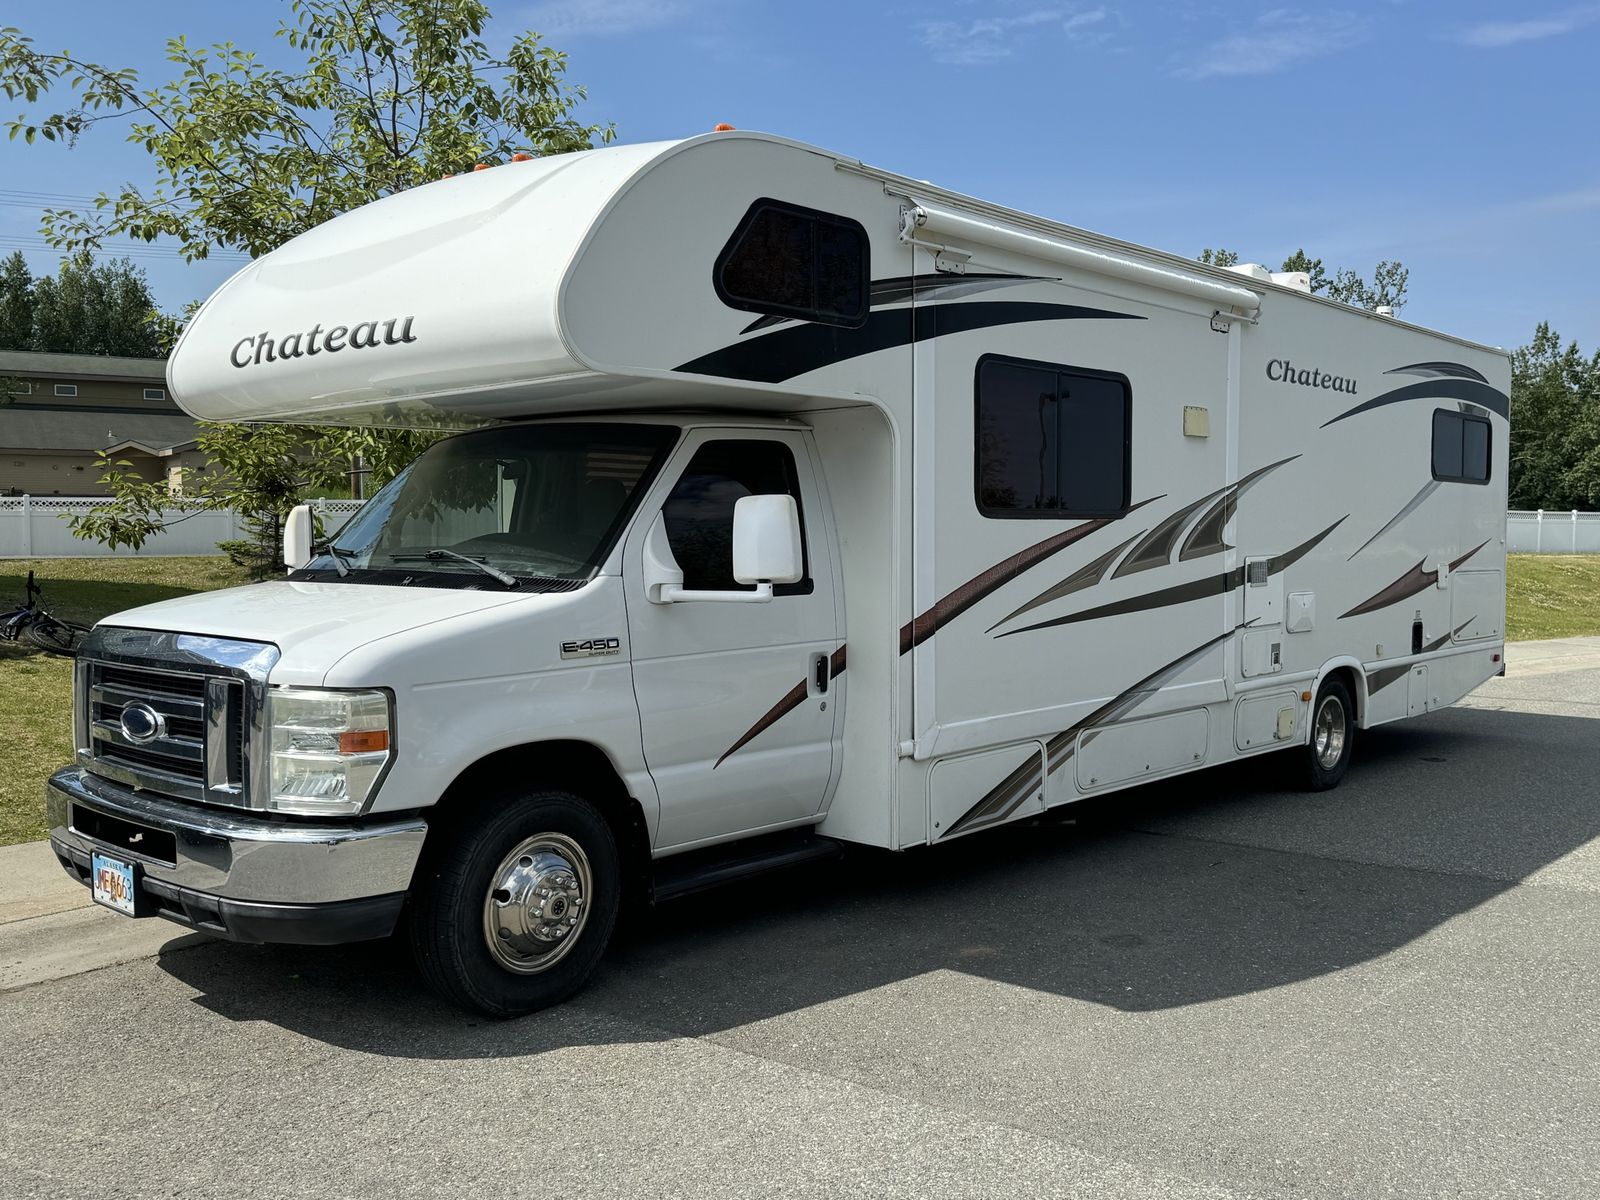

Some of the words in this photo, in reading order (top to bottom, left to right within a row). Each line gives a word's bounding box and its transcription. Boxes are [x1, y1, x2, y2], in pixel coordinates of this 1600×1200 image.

[230, 315, 417, 368] Chateau
[1266, 359, 1357, 395] Chateau
[562, 638, 619, 652] E-450
